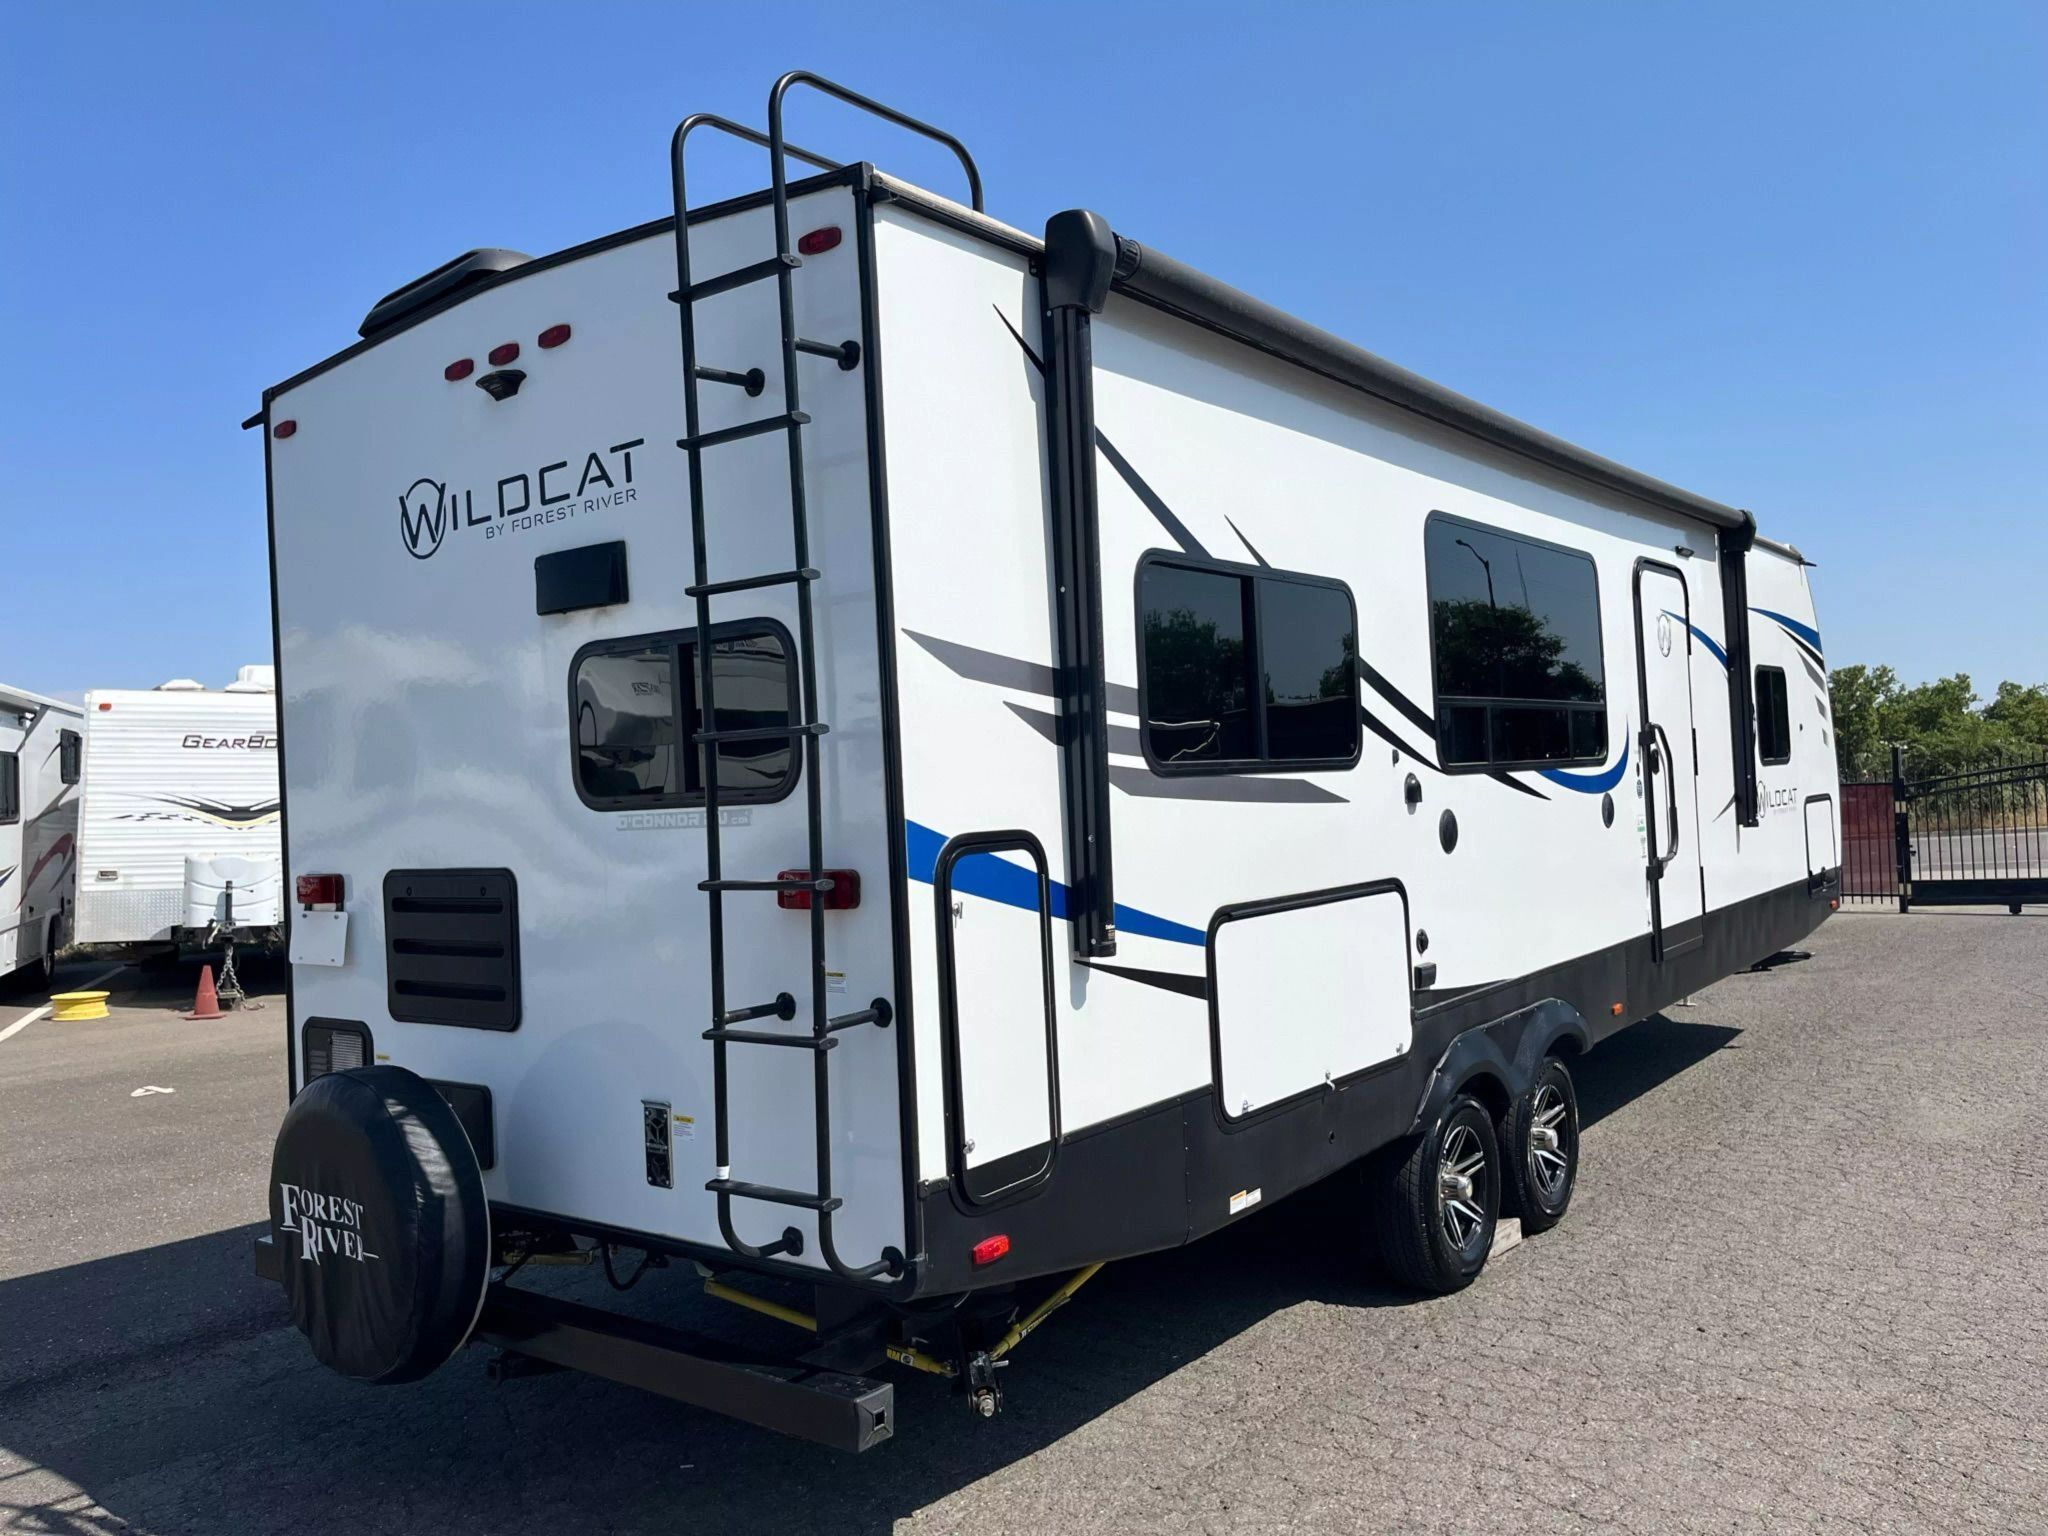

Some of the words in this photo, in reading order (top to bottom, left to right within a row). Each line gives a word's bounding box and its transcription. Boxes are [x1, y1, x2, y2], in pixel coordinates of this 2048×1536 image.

[399, 438, 645, 559] WILDCAT
[485, 523, 505, 540] BY
[511, 503, 577, 532] FOREST
[583, 488, 638, 513] RIVER
[280, 1183, 364, 1230] FOREST
